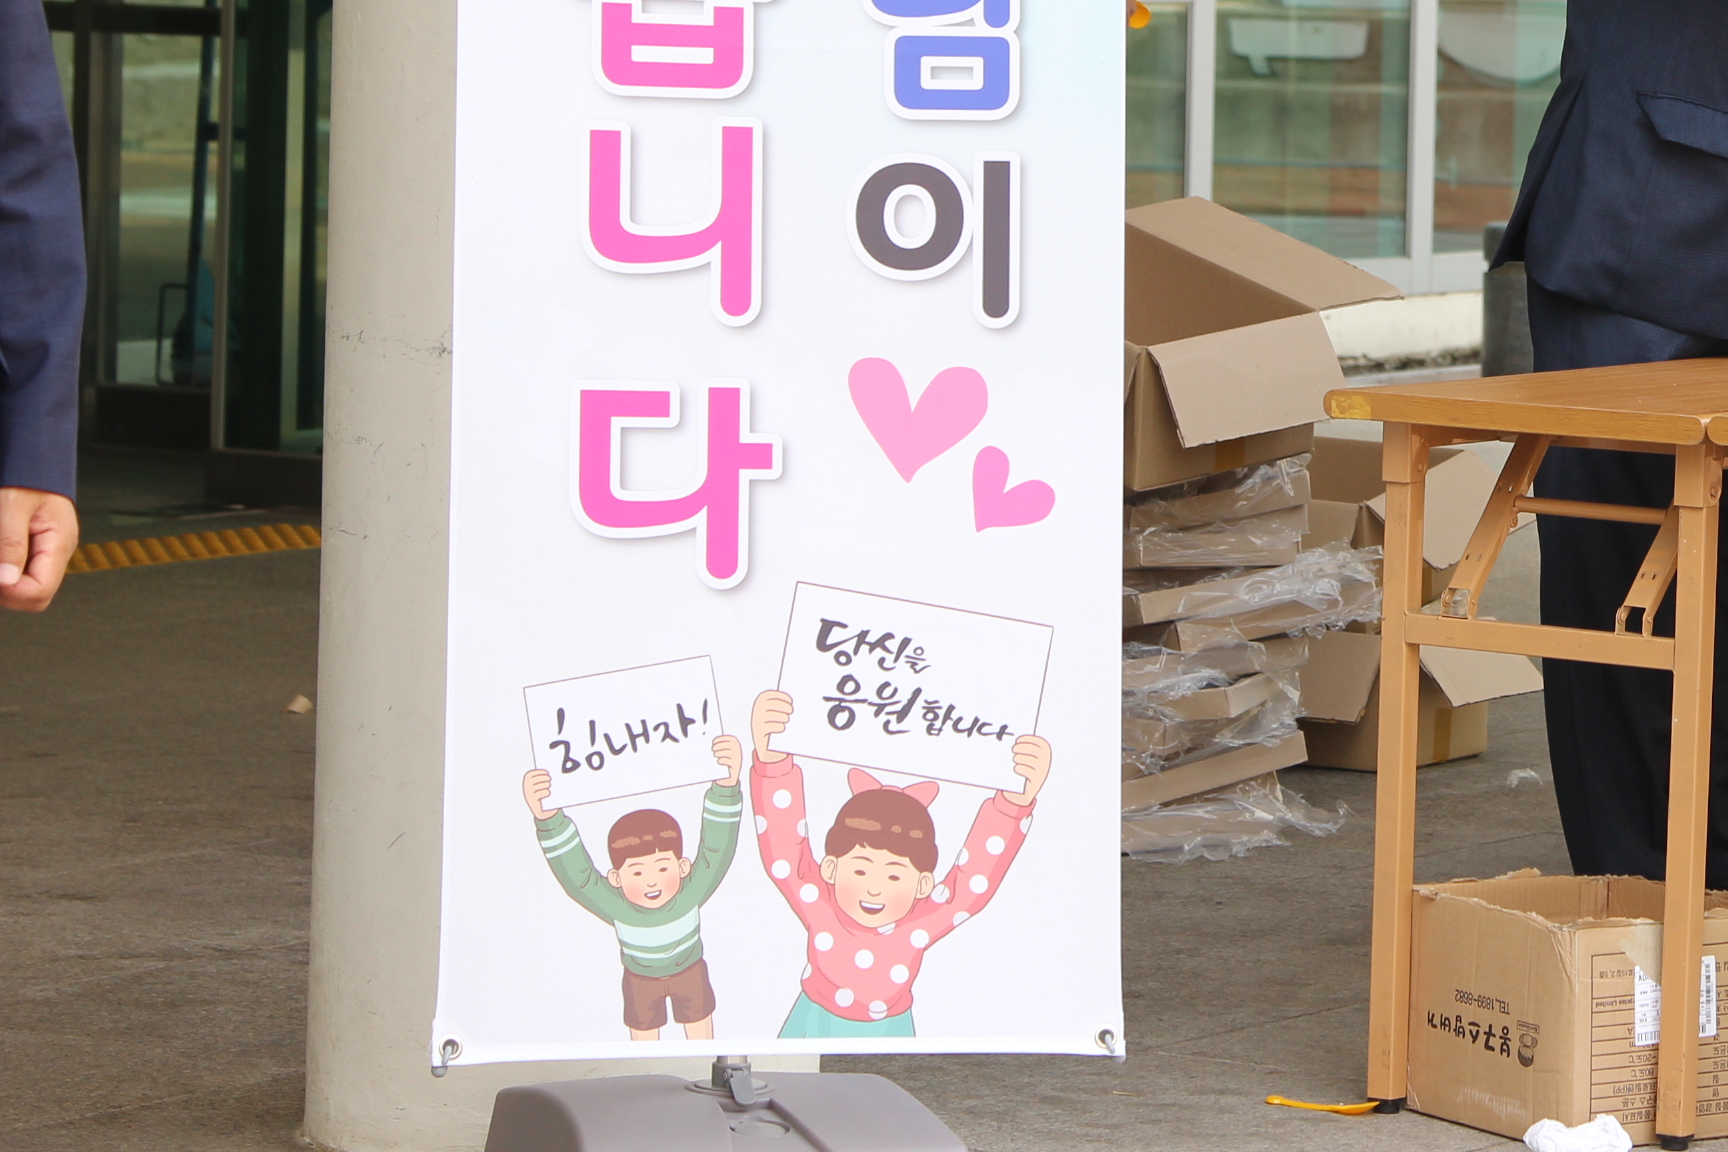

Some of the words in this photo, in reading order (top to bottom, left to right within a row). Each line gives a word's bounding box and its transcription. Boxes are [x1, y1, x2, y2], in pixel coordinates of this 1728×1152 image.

[815, 617, 931, 675] 당신을
[822, 673, 1015, 744] 응원합니다
[548, 697, 709, 774] 힘내자!
[1619, 998, 1634, 1006] rprise
[1427, 1010, 1512, 1058] 봉구스밥버거
[1696, 1103, 1713, 1113] 경영
